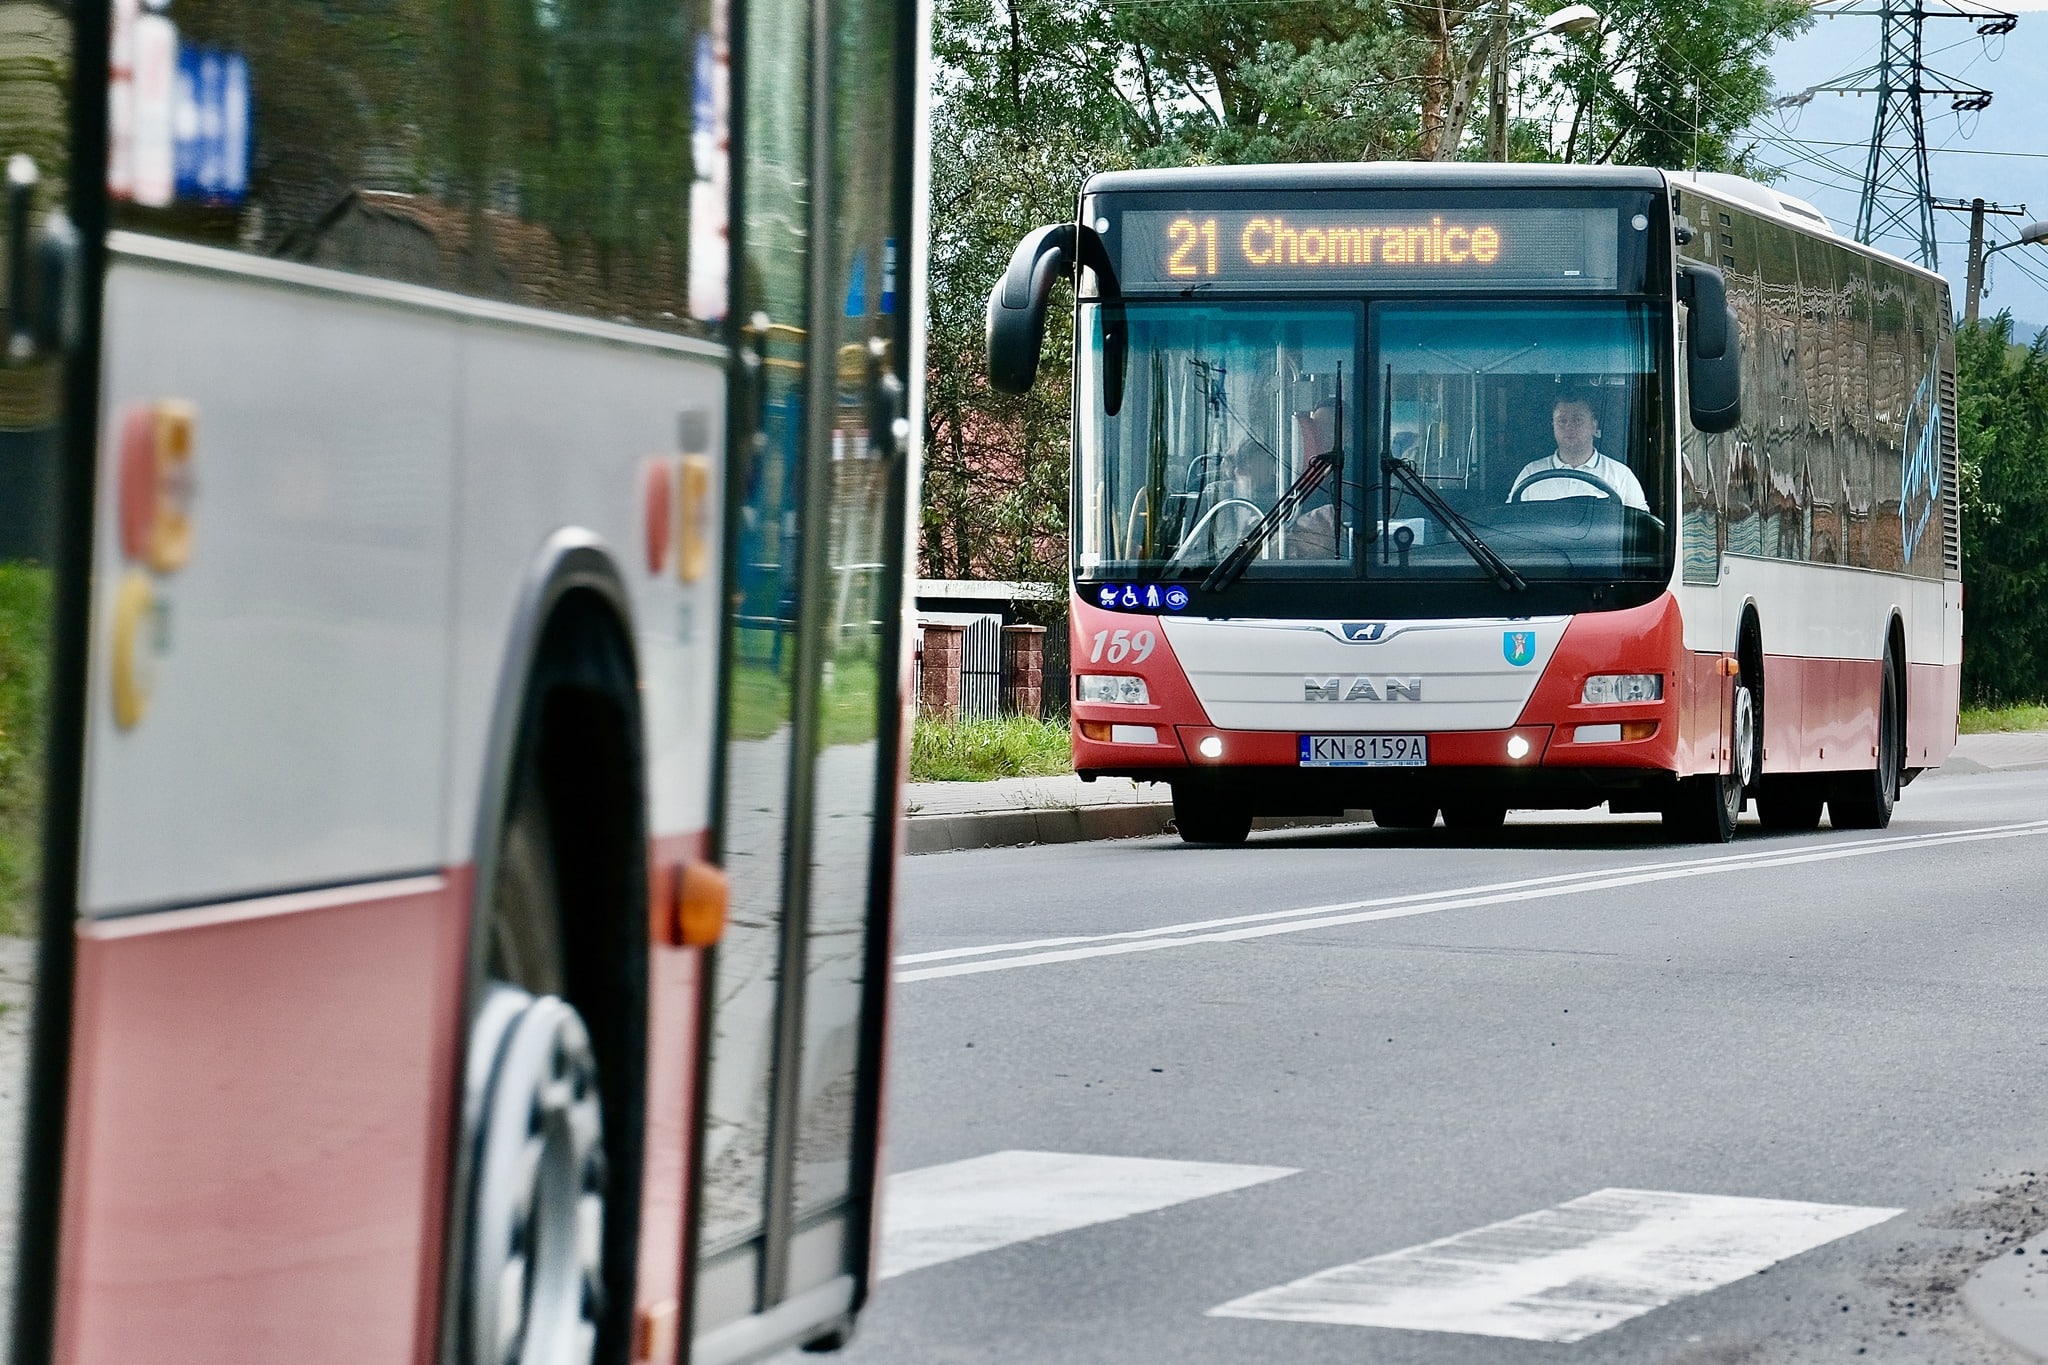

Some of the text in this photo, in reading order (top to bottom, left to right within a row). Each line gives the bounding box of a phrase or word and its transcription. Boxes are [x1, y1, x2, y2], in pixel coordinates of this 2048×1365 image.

[1168, 216, 1500, 275] 21 Chomranice
[1090, 629, 1156, 665] 159
[1304, 676, 1423, 701] MAN
[1314, 738, 1423, 760] KN 8159A
